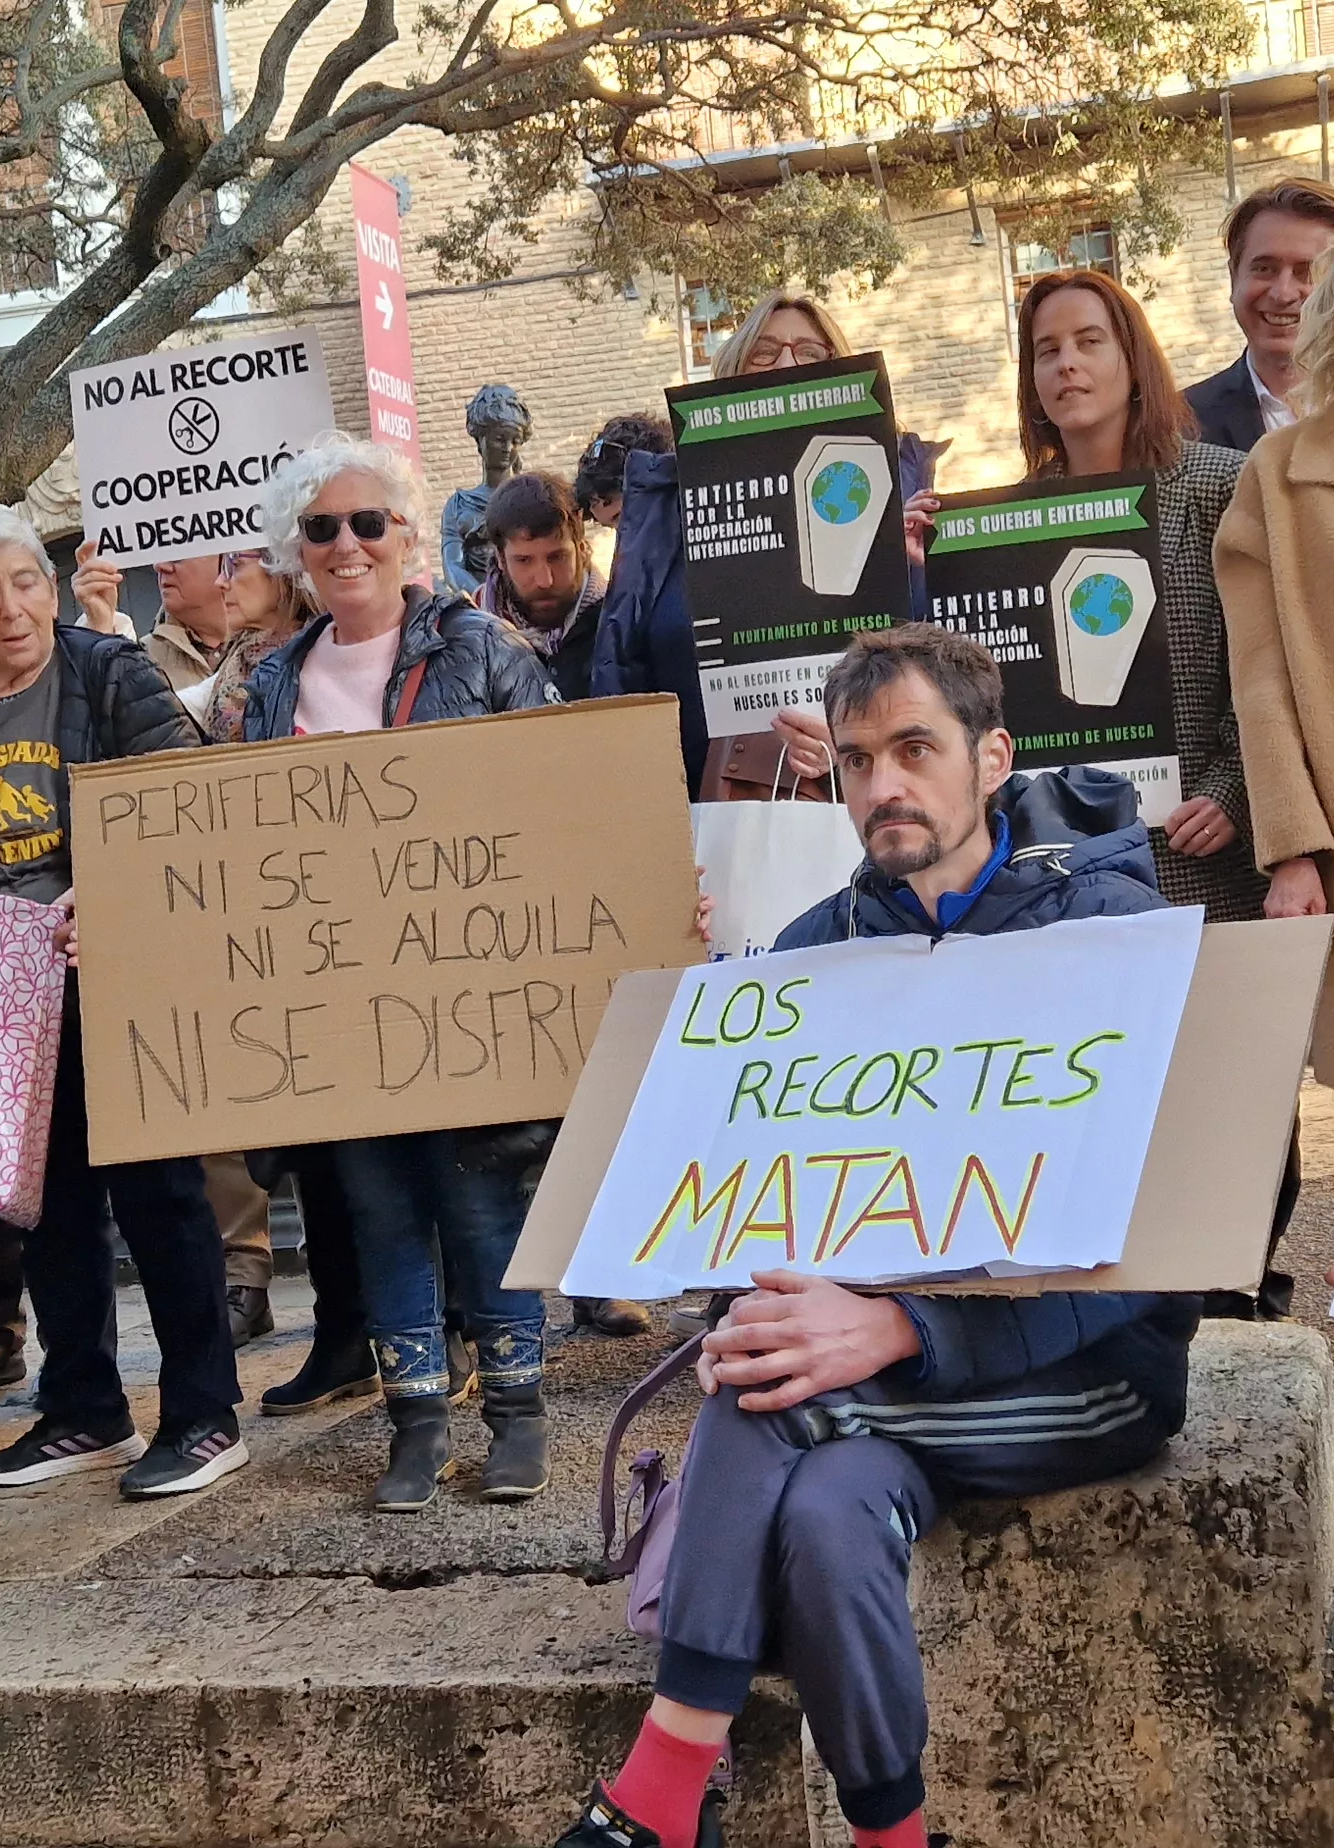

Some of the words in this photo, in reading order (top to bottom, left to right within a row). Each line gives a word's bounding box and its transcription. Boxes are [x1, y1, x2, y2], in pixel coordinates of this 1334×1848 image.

[357, 219, 400, 274] VISITA
[84, 377, 124, 410] NO
[130, 368, 165, 400] AL
[171, 343, 309, 392] RECORTE
[368, 366, 414, 406] CATEDRAL
[378, 408, 411, 441] MUSEO
[689, 407, 722, 429] ¡NOS
[727, 396, 785, 423] QUIEREN
[790, 383, 866, 413] ENTERRAR!
[92, 441, 304, 509] COOPERACIÓ
[685, 475, 789, 508] ENTIERRO
[97, 525, 133, 556] AL
[136, 504, 264, 550] DESARRO
[687, 508, 716, 526] POR
[727, 503, 745, 519] LA
[687, 515, 772, 543] COOPERACIÓN
[941, 517, 976, 539] ¡NOS
[980, 509, 1042, 534] QUIEREN
[1048, 498, 1131, 525] ENTERRAR!
[688, 533, 785, 561] INTERNACIONAL
[932, 586, 1045, 617] ENTIERRO
[979, 613, 999, 629] LA
[732, 622, 817, 645] AYUNTAMIENTO
[823, 619, 838, 633] DE
[843, 614, 892, 632] HUESCA
[966, 624, 1028, 647] ERACIÓN
[709, 678, 723, 692] NO
[728, 676, 740, 690] AL
[743, 669, 791, 687] RECORTE
[797, 667, 811, 681] EN
[733, 693, 779, 712] HUESCA
[784, 690, 799, 705] ES
[1012, 731, 1079, 751] NTAMIENTO
[1085, 729, 1100, 744] DE
[1105, 724, 1154, 742] HUESCA
[100, 756, 418, 844] PERIFERIAS
[165, 859, 227, 914] NI
[260, 850, 332, 911] SE
[373, 832, 522, 899] VENDE
[227, 926, 275, 981] NI
[304, 919, 363, 976] SE
[392, 894, 627, 965] ALQUILA
[678, 976, 811, 1048] LOS
[128, 1005, 209, 1122] NI
[227, 1003, 335, 1104] SE
[727, 1030, 1127, 1125] RECORTES
[633, 1150, 1047, 1270] MATAN
